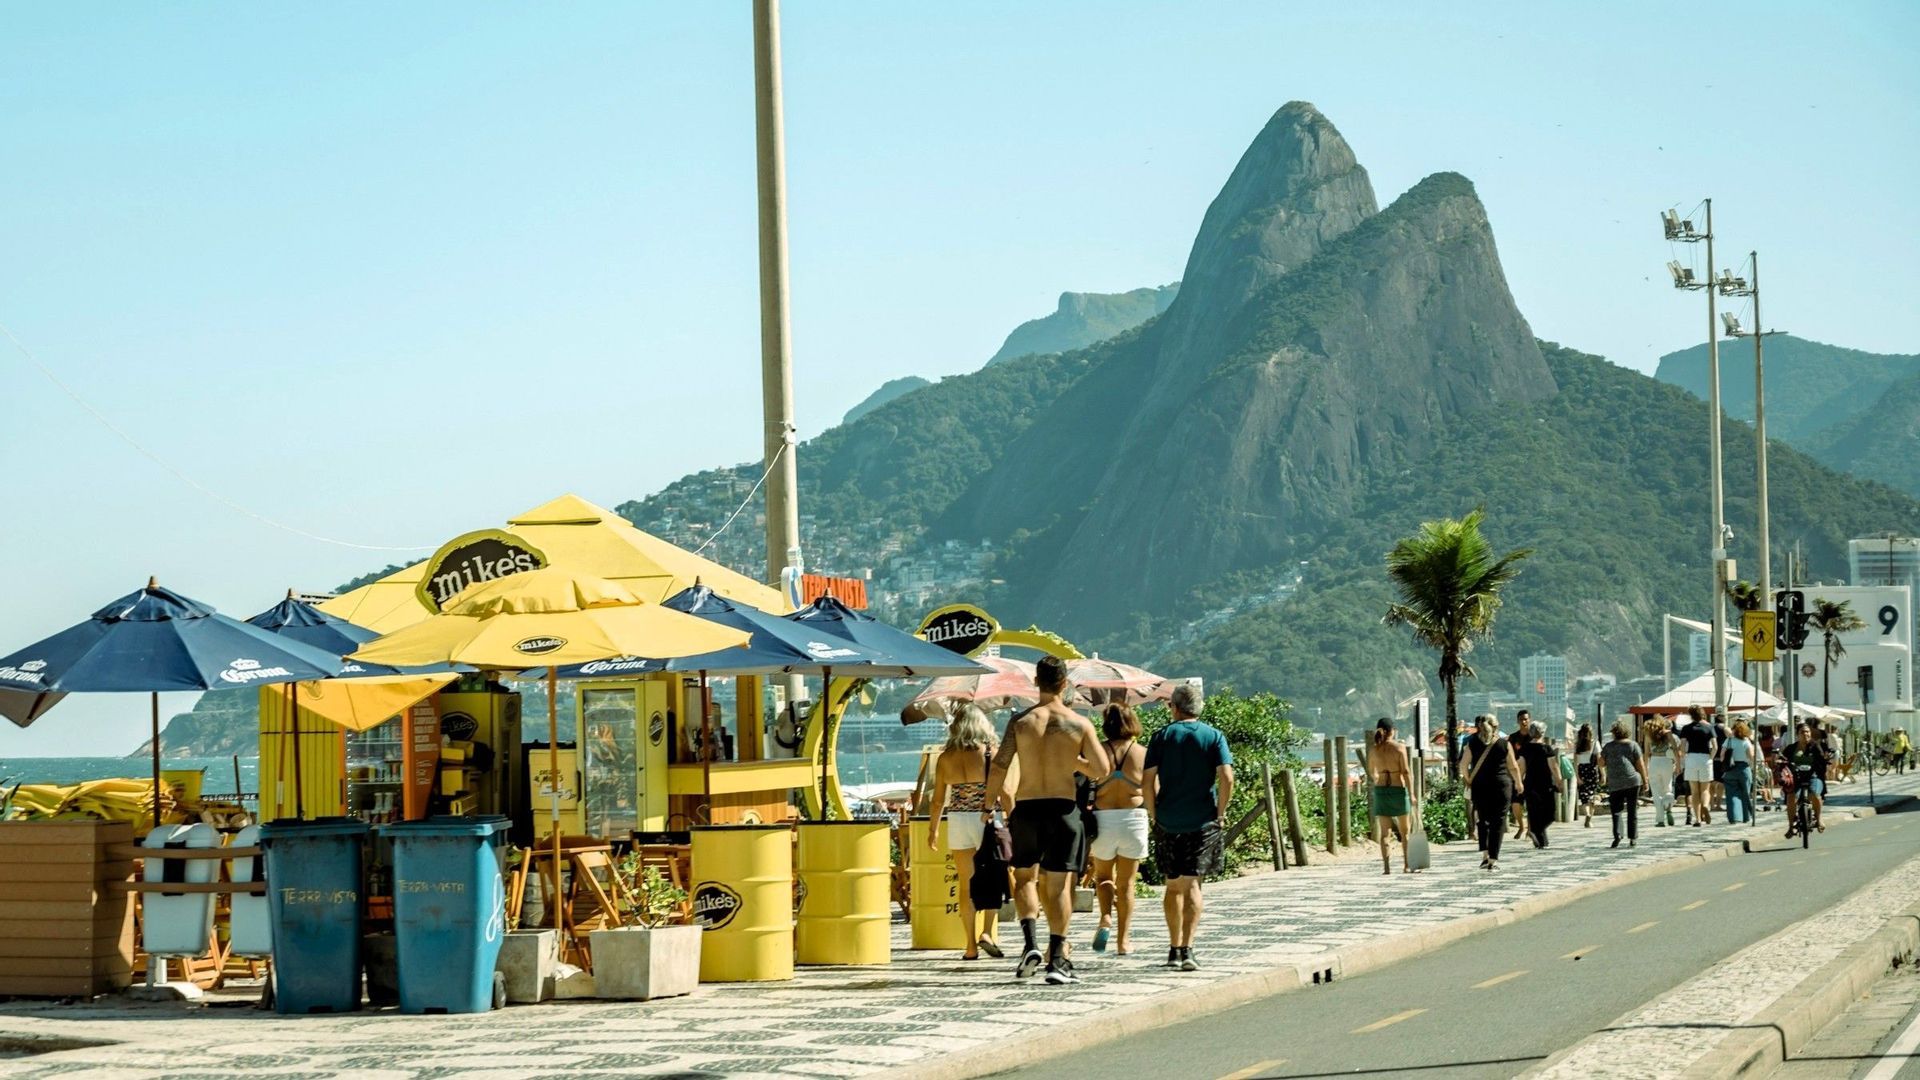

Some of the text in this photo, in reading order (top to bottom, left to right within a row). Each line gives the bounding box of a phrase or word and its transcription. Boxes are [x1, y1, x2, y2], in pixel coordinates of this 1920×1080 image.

[432, 549, 535, 603] mike's
[1878, 605, 1899, 635] 9
[924, 617, 990, 643] mike's
[520, 638, 562, 651] mike's
[220, 667, 290, 683] Corona
[580, 660, 647, 675] Corona
[949, 886, 957, 897] E
